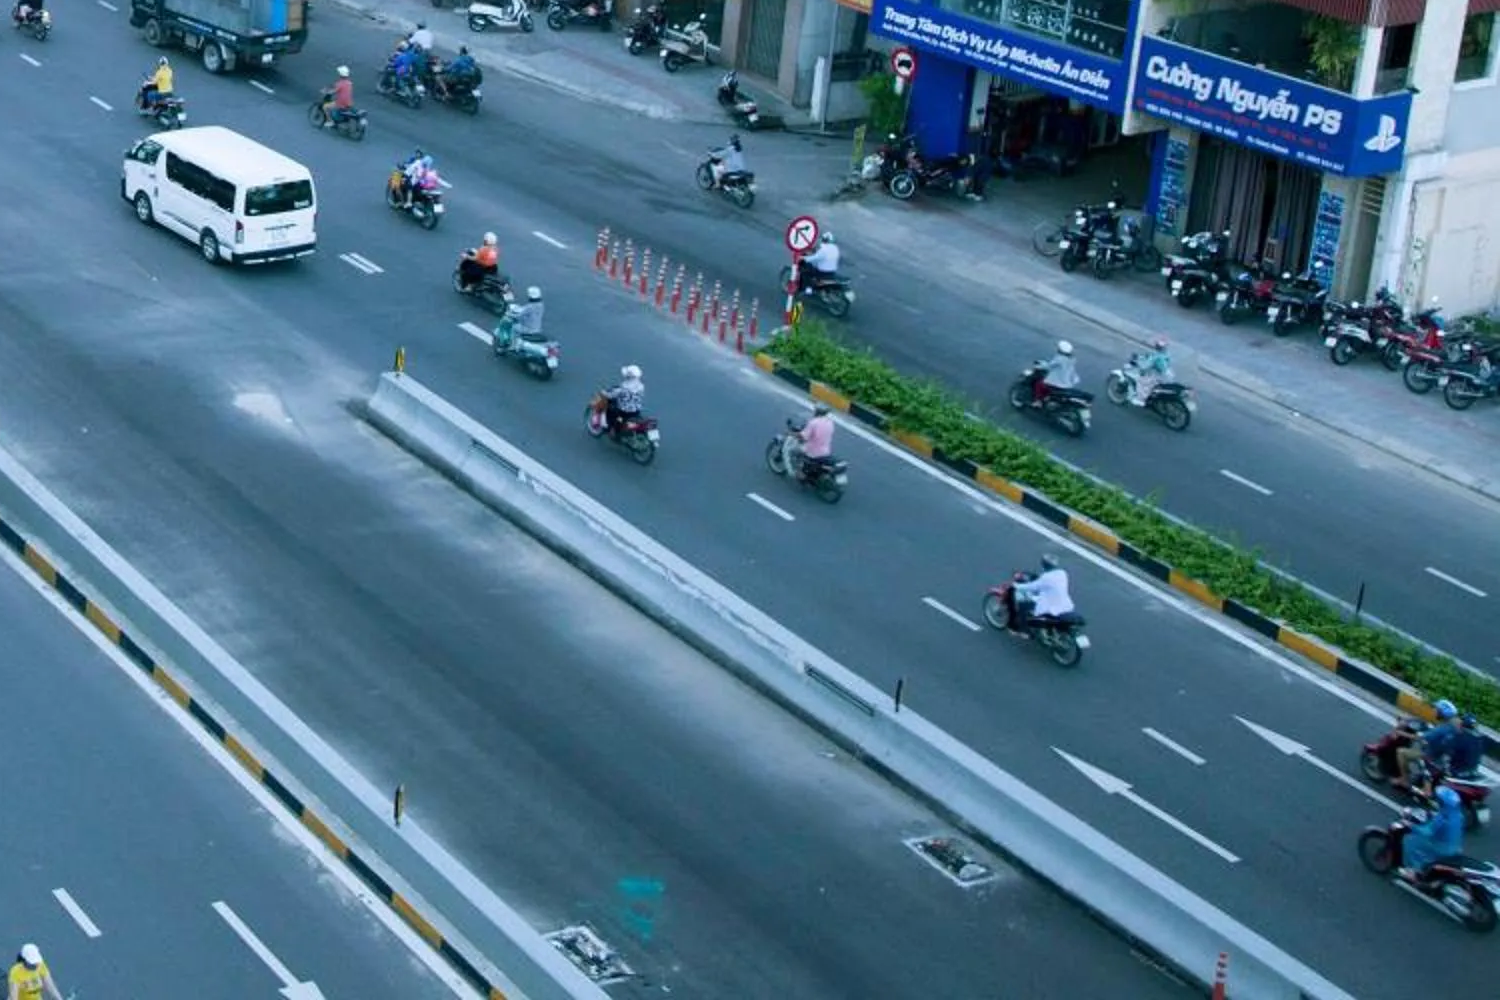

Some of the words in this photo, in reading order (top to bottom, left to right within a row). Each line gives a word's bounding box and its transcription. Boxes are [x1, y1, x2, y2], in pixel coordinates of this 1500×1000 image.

[884, 6, 917, 30] Trung
[918, 15, 941, 36] Tâm
[942, 24, 969, 44] Dịch
[969, 32, 985, 53] Vụ
[985, 39, 1010, 58] Lốp
[1009, 46, 1061, 74] Michelin
[1060, 59, 1079, 80] Ân
[1146, 55, 1214, 102] Cường
[1216, 76, 1299, 124] Nguyễn
[1303, 103, 1343, 135] PS
